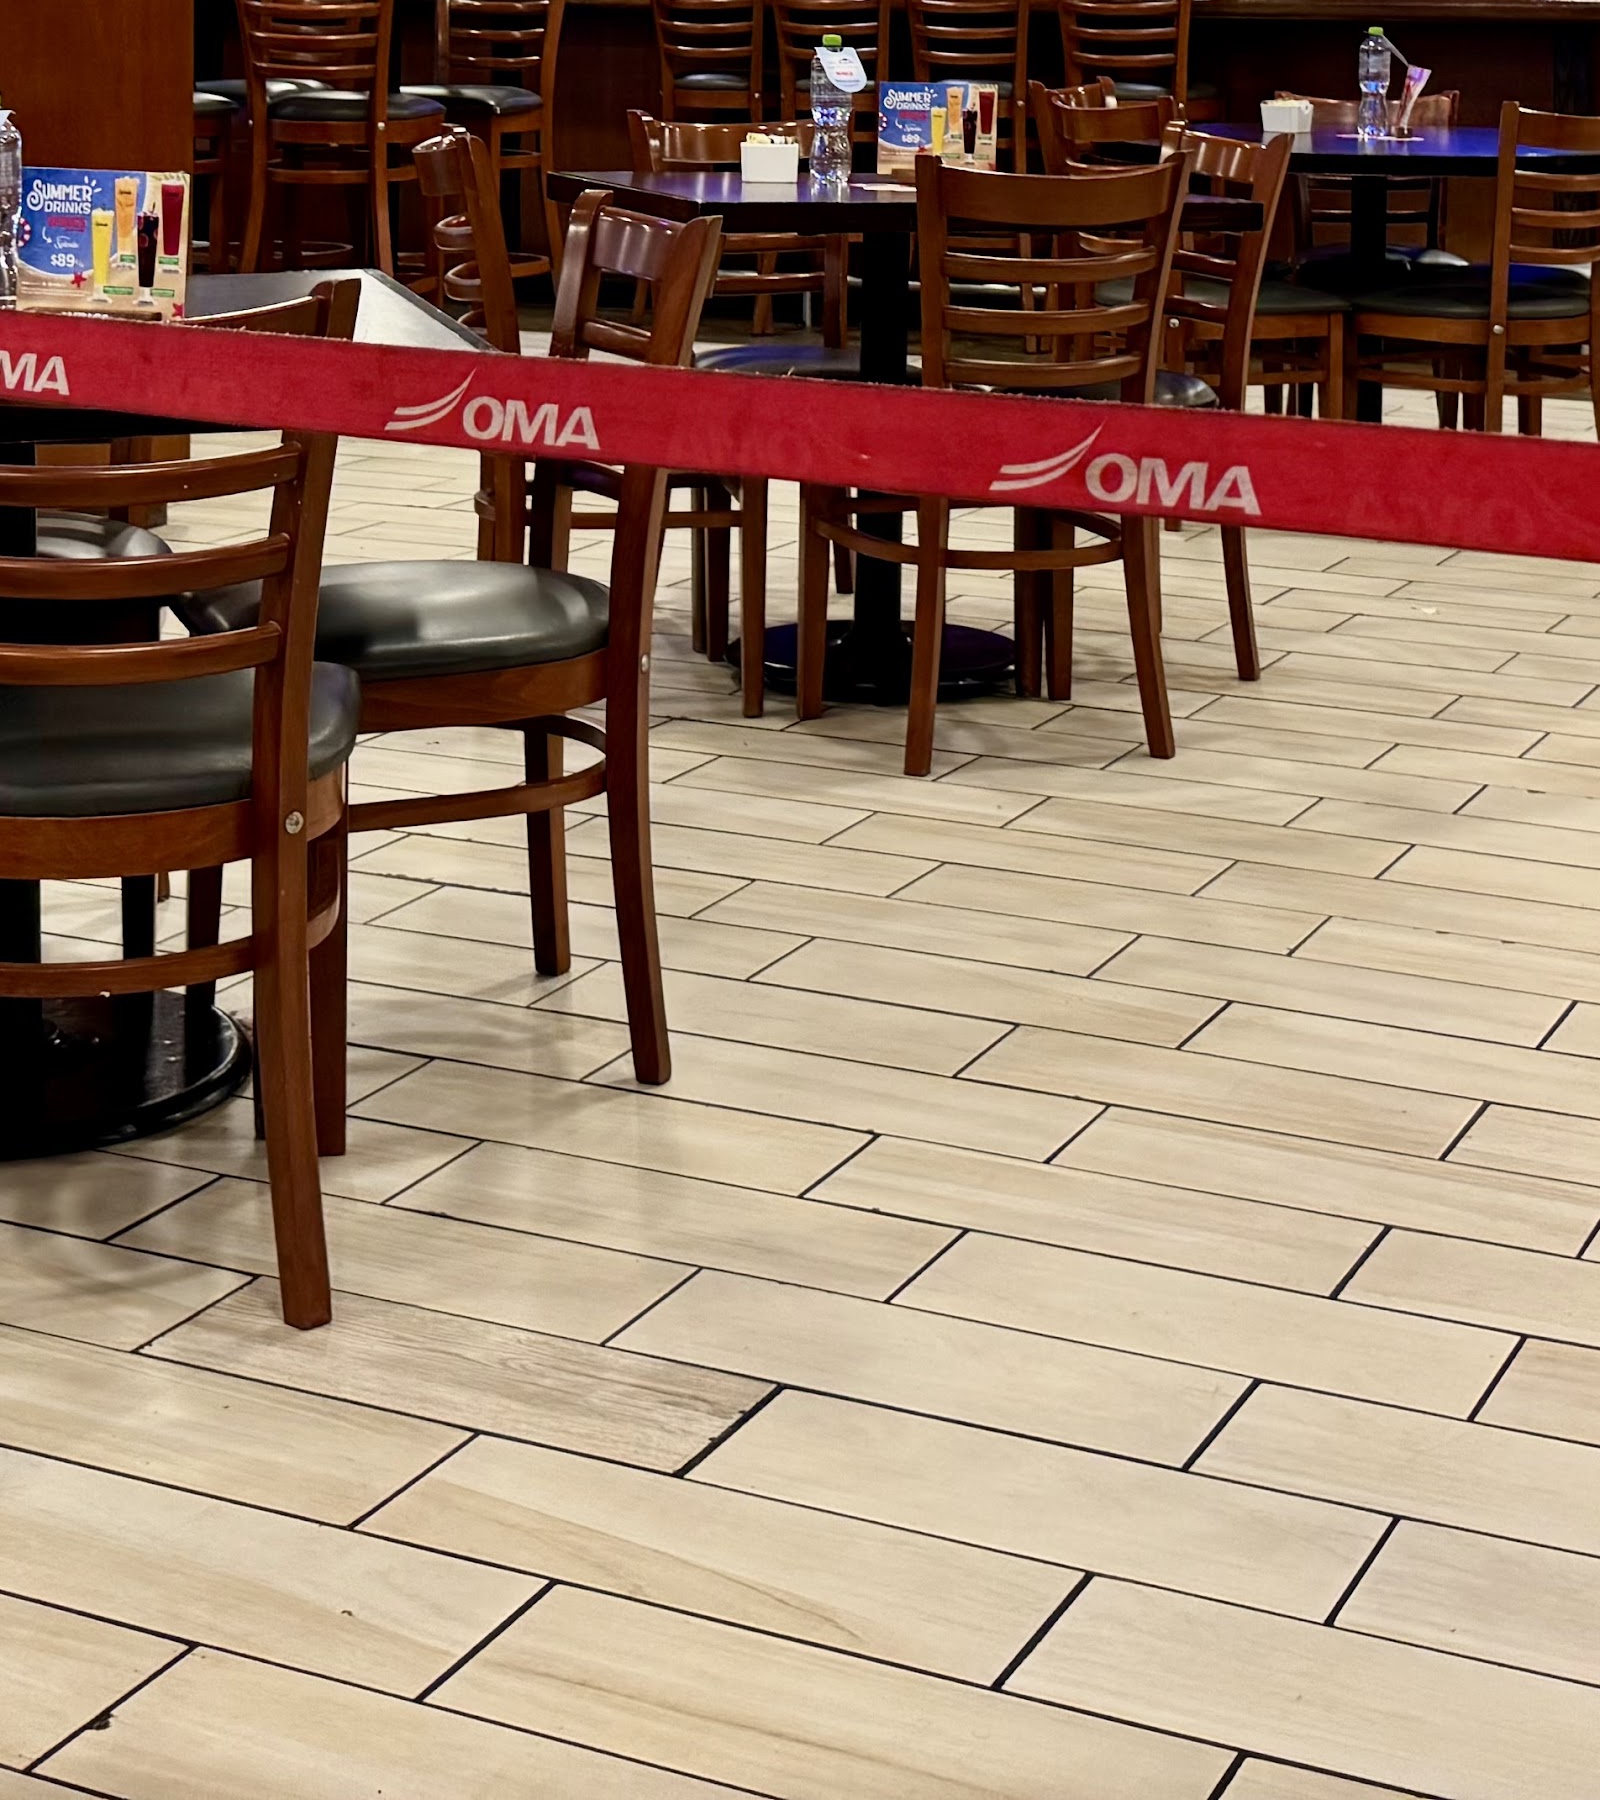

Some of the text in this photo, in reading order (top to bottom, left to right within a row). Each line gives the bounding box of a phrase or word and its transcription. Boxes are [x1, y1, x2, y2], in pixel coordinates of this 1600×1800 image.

[884, 89, 931, 109] SUMMER
[27, 179, 92, 211] SUMMER
[44, 201, 92, 215] DRINKS
[462, 396, 600, 450] OMA
[1086, 453, 1261, 516] OMA
